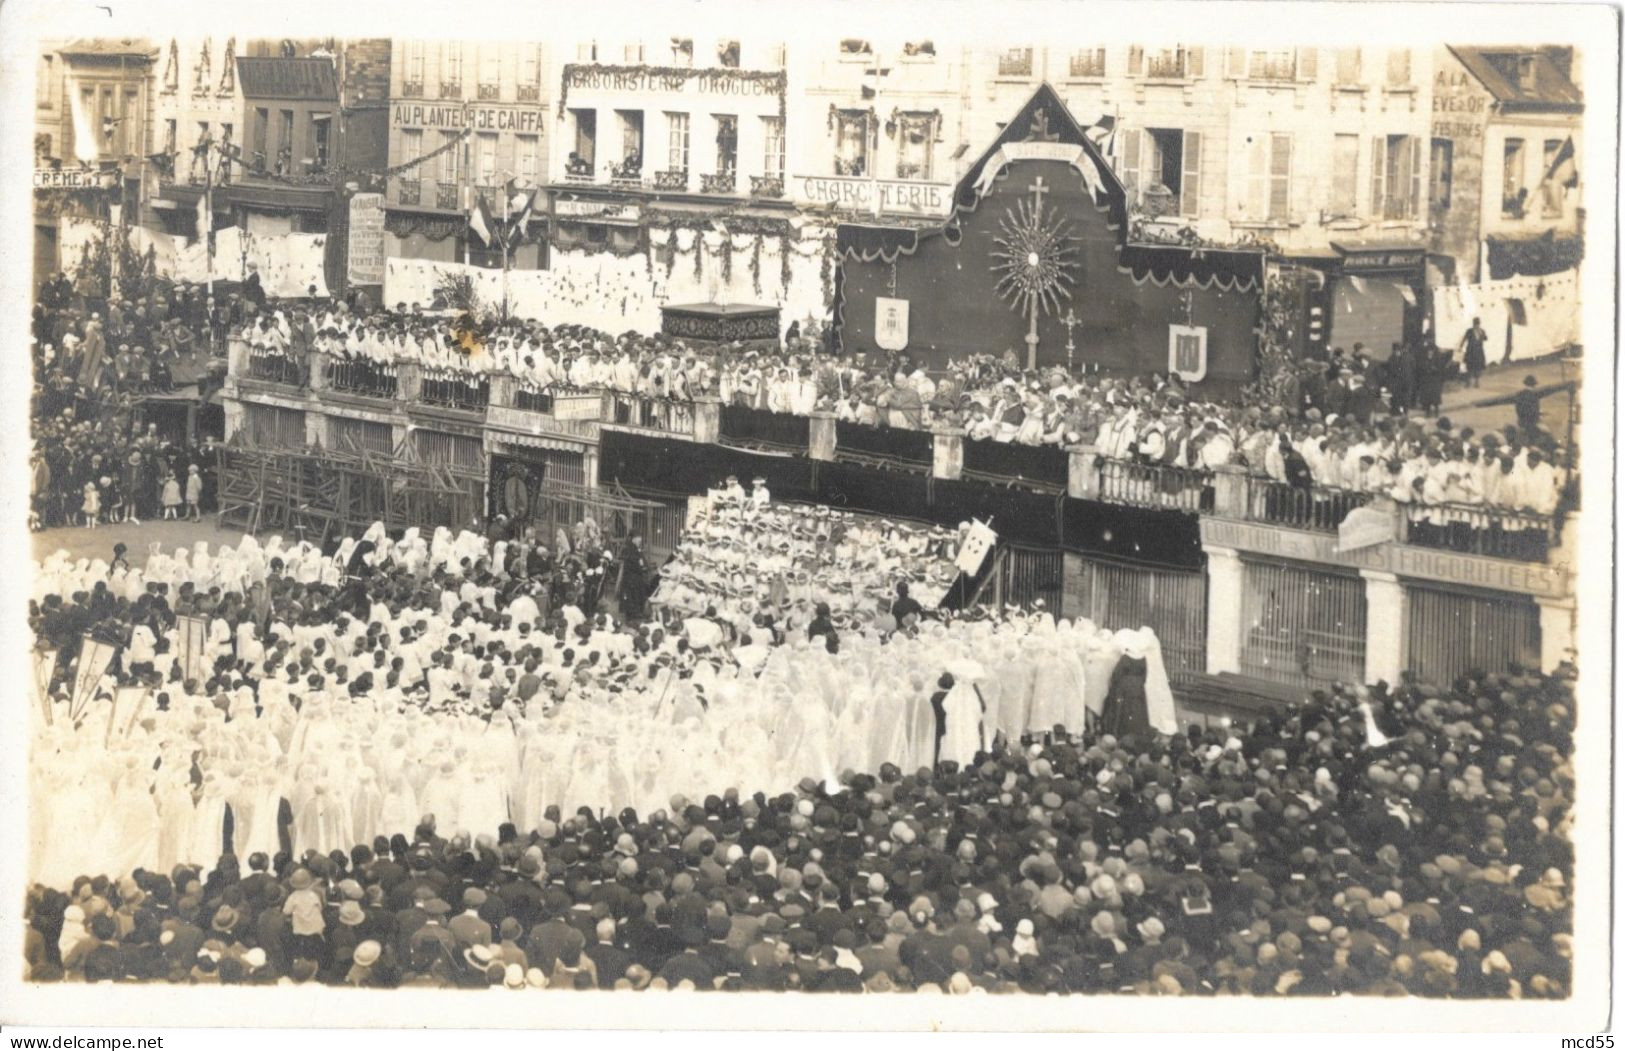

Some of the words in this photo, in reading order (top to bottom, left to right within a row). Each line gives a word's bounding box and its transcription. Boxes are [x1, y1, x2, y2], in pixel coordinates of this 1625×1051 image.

[394, 105, 411, 124] AU
[413, 106, 476, 127] PLANTEUR
[478, 110, 495, 129] DE
[498, 110, 544, 131] CAIFFA
[804, 178, 942, 208] CHARCTERIE
